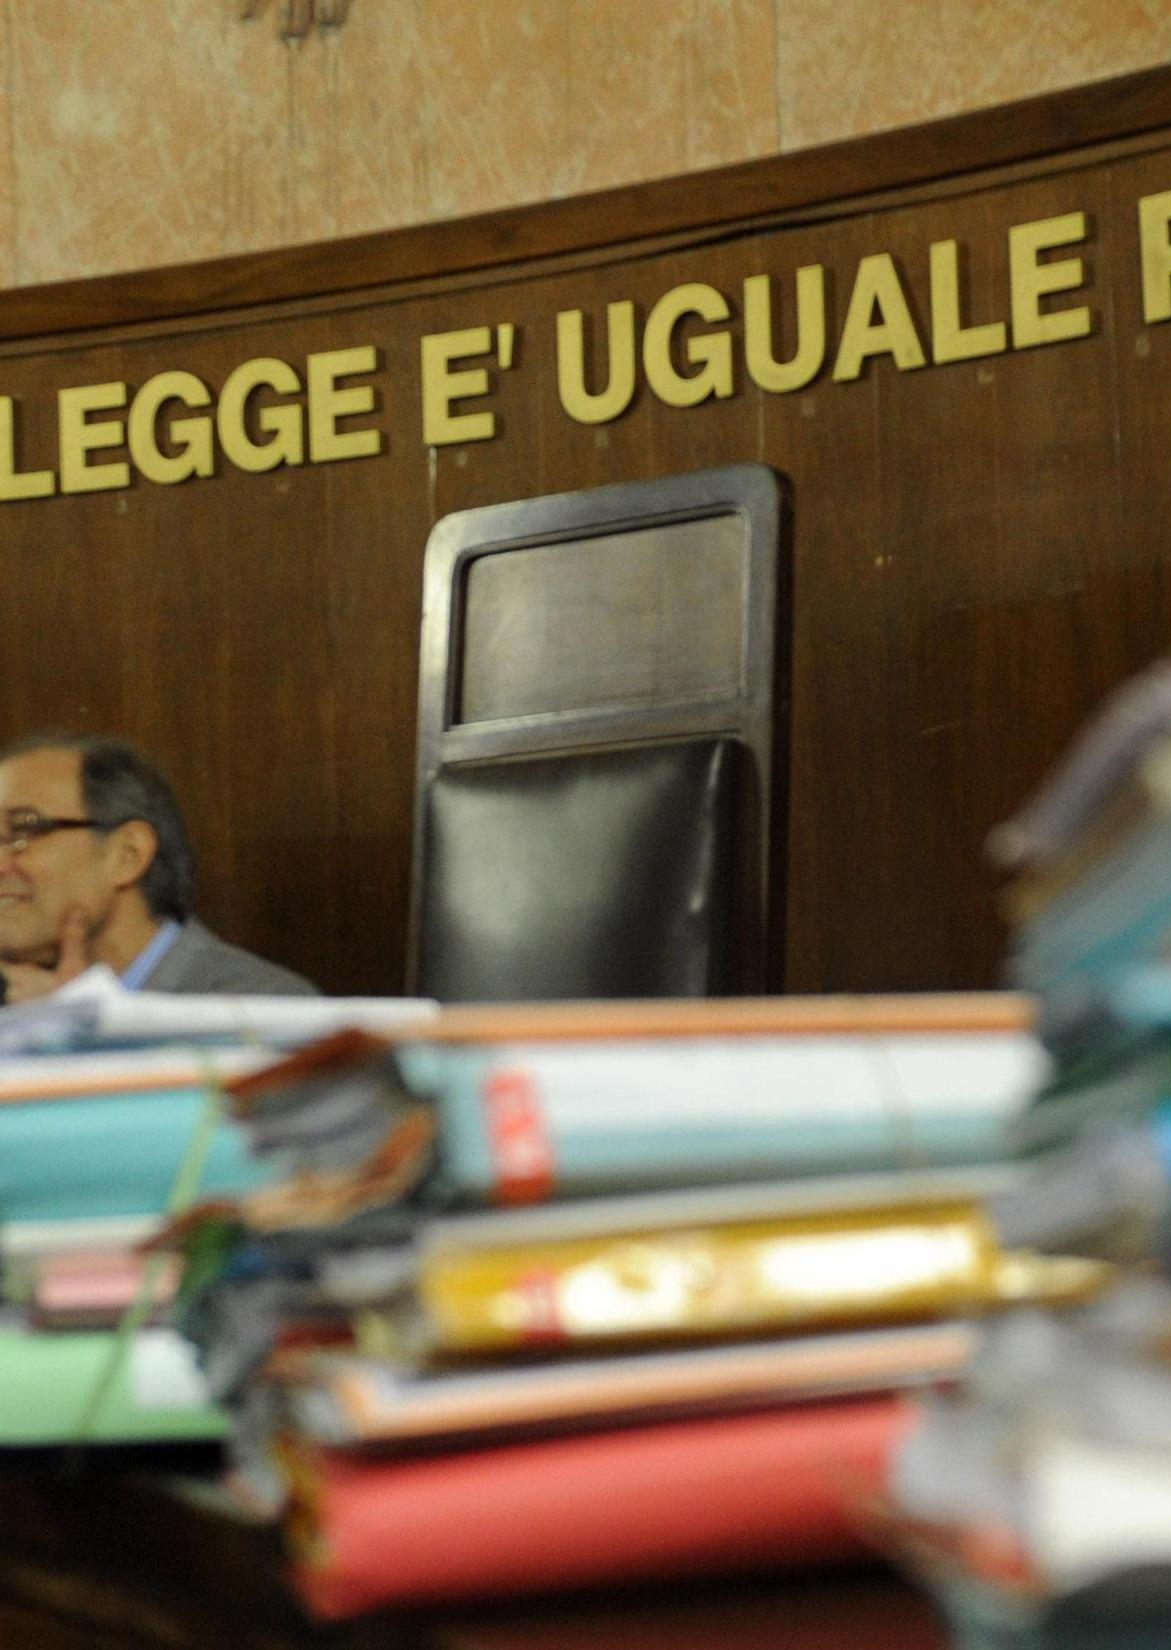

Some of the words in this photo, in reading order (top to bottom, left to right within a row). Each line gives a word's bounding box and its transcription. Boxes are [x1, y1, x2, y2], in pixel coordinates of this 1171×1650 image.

[0, 345, 381, 501] LEGGE
[420, 322, 515, 447] E'
[556, 211, 1091, 425] UGUALE
